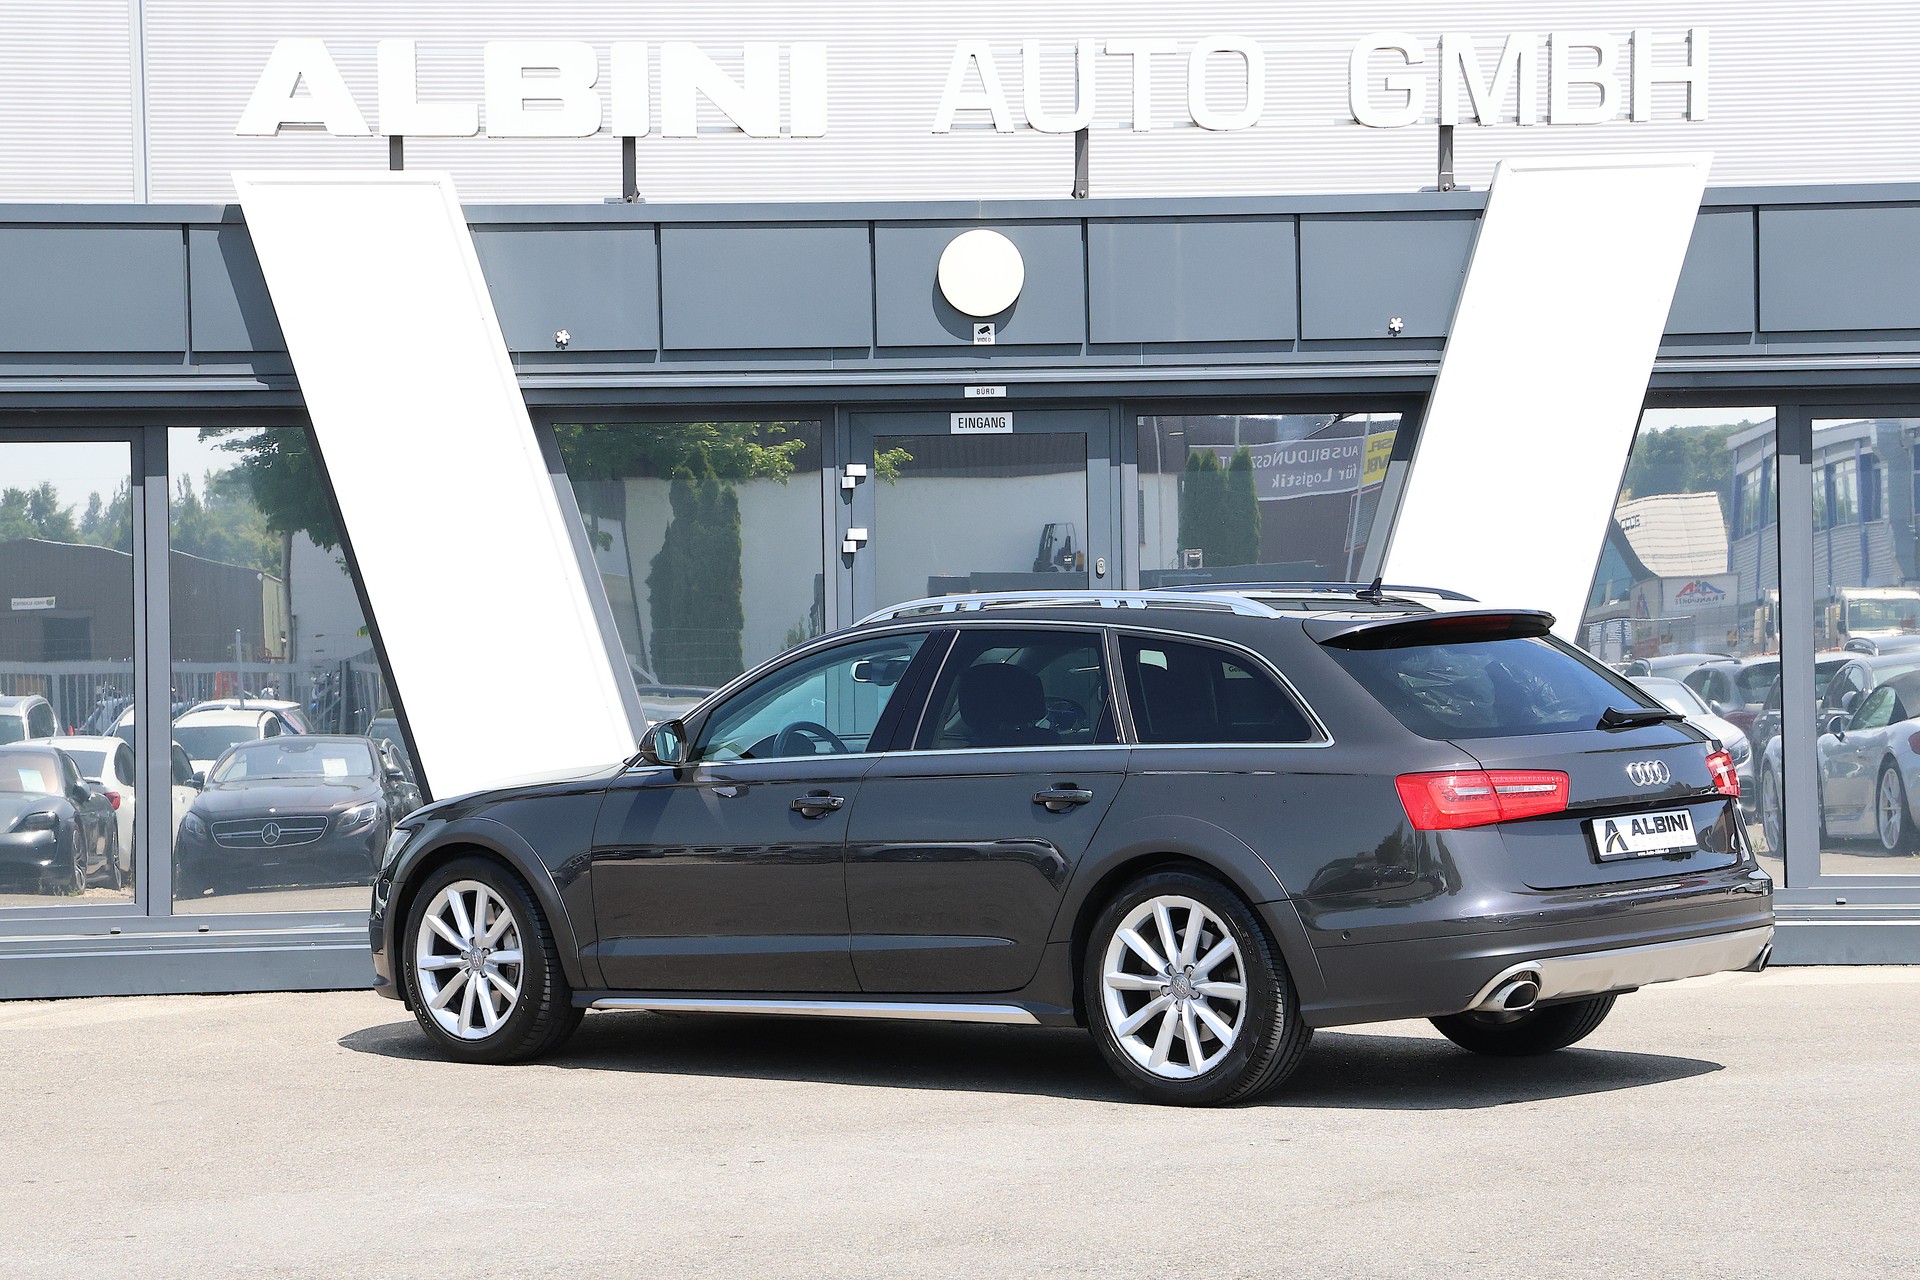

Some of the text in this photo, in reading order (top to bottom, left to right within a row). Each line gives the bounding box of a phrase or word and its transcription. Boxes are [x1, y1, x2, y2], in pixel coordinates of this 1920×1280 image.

[234, 27, 1710, 138] ALBINI AUTO GMBH
[976, 386, 995, 395] BÜRO
[958, 416, 1006, 429] EINGANG
[1631, 814, 1689, 836] ALBINI
